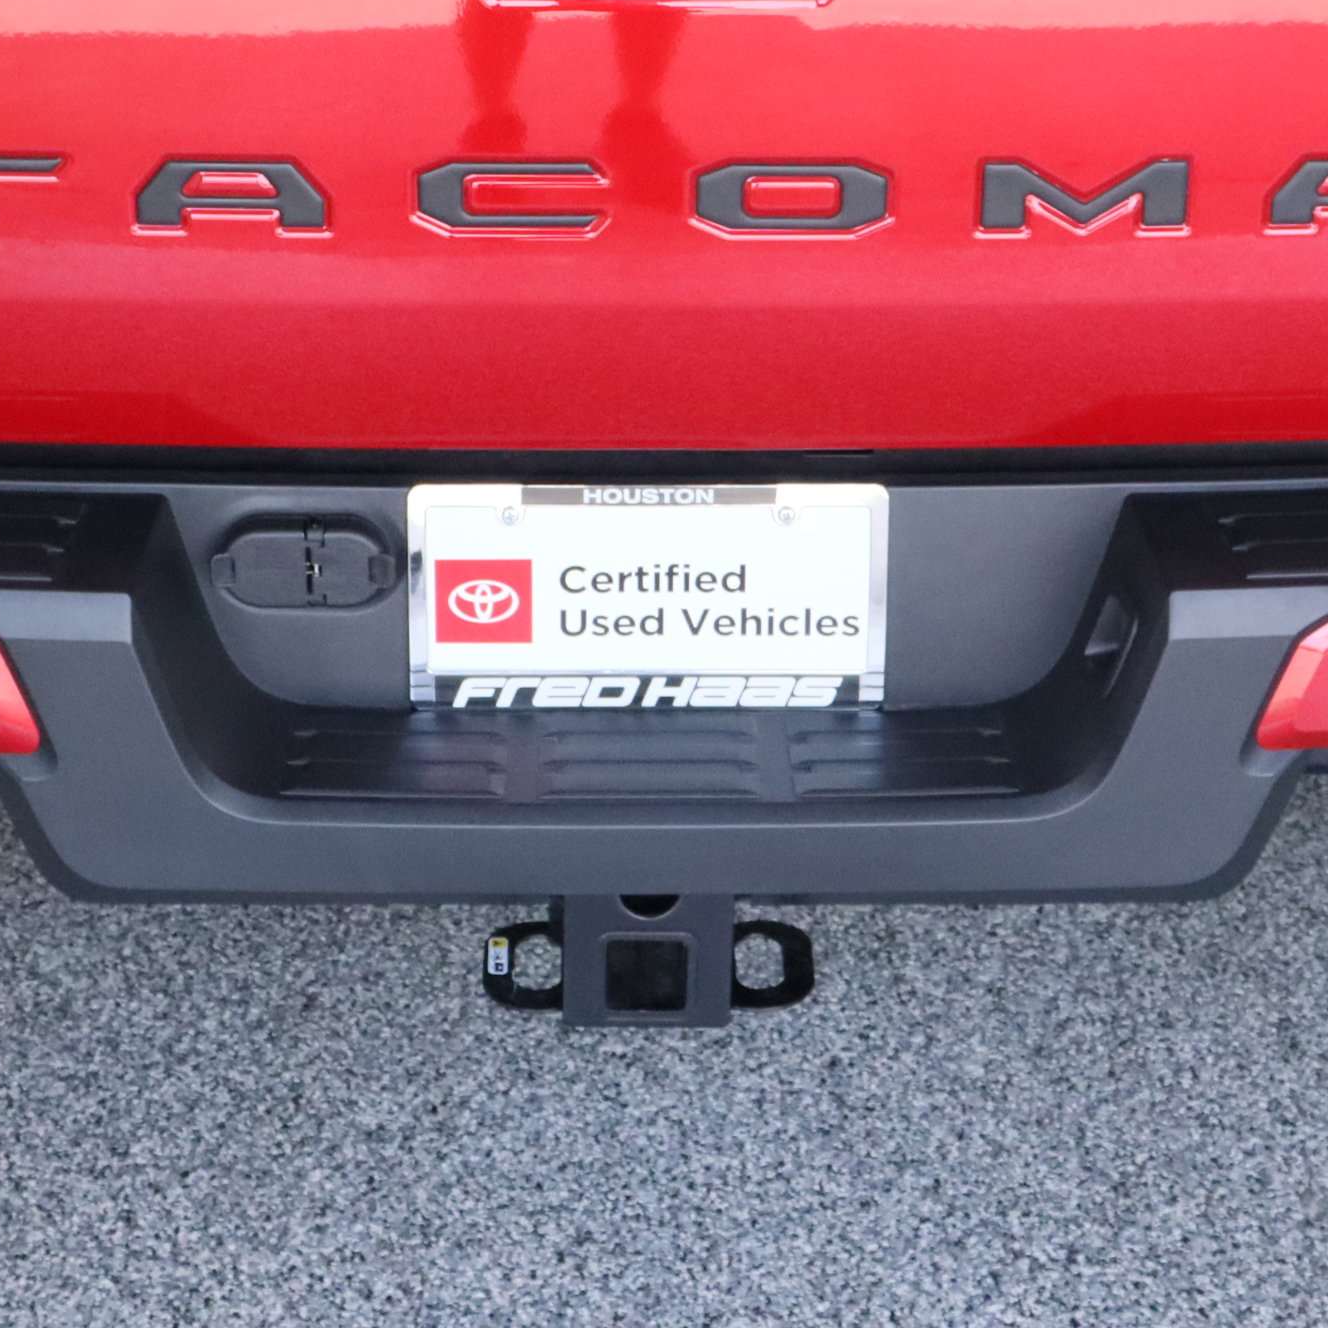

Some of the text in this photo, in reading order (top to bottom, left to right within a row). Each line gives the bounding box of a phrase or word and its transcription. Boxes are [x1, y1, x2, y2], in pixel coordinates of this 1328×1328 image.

[582, 488, 715, 505] HOUSTON
[559, 564, 747, 593] Certified
[560, 607, 860, 637] Used Vehicles
